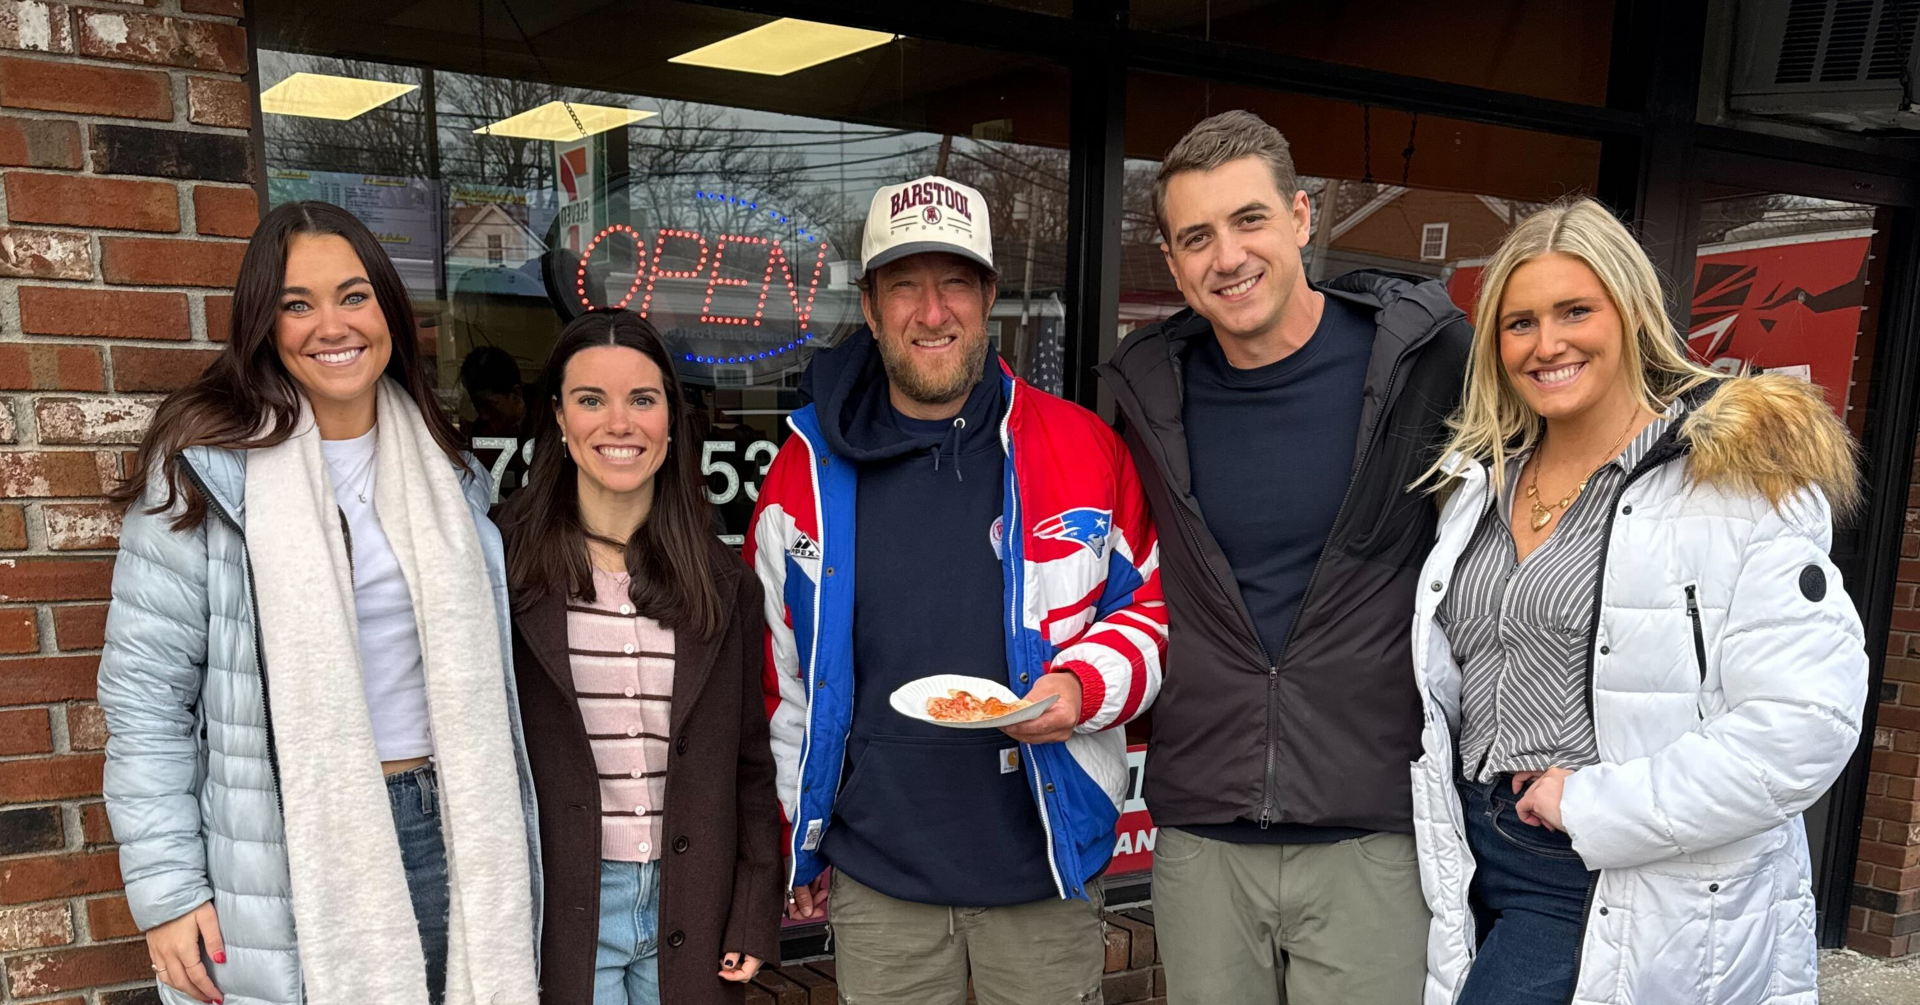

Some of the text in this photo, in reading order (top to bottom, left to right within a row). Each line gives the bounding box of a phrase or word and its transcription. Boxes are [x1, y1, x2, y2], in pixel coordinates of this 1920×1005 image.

[890, 182, 972, 222] BARSTOOL
[890, 225, 973, 239] SPORTS
[576, 225, 829, 330] OPEN
